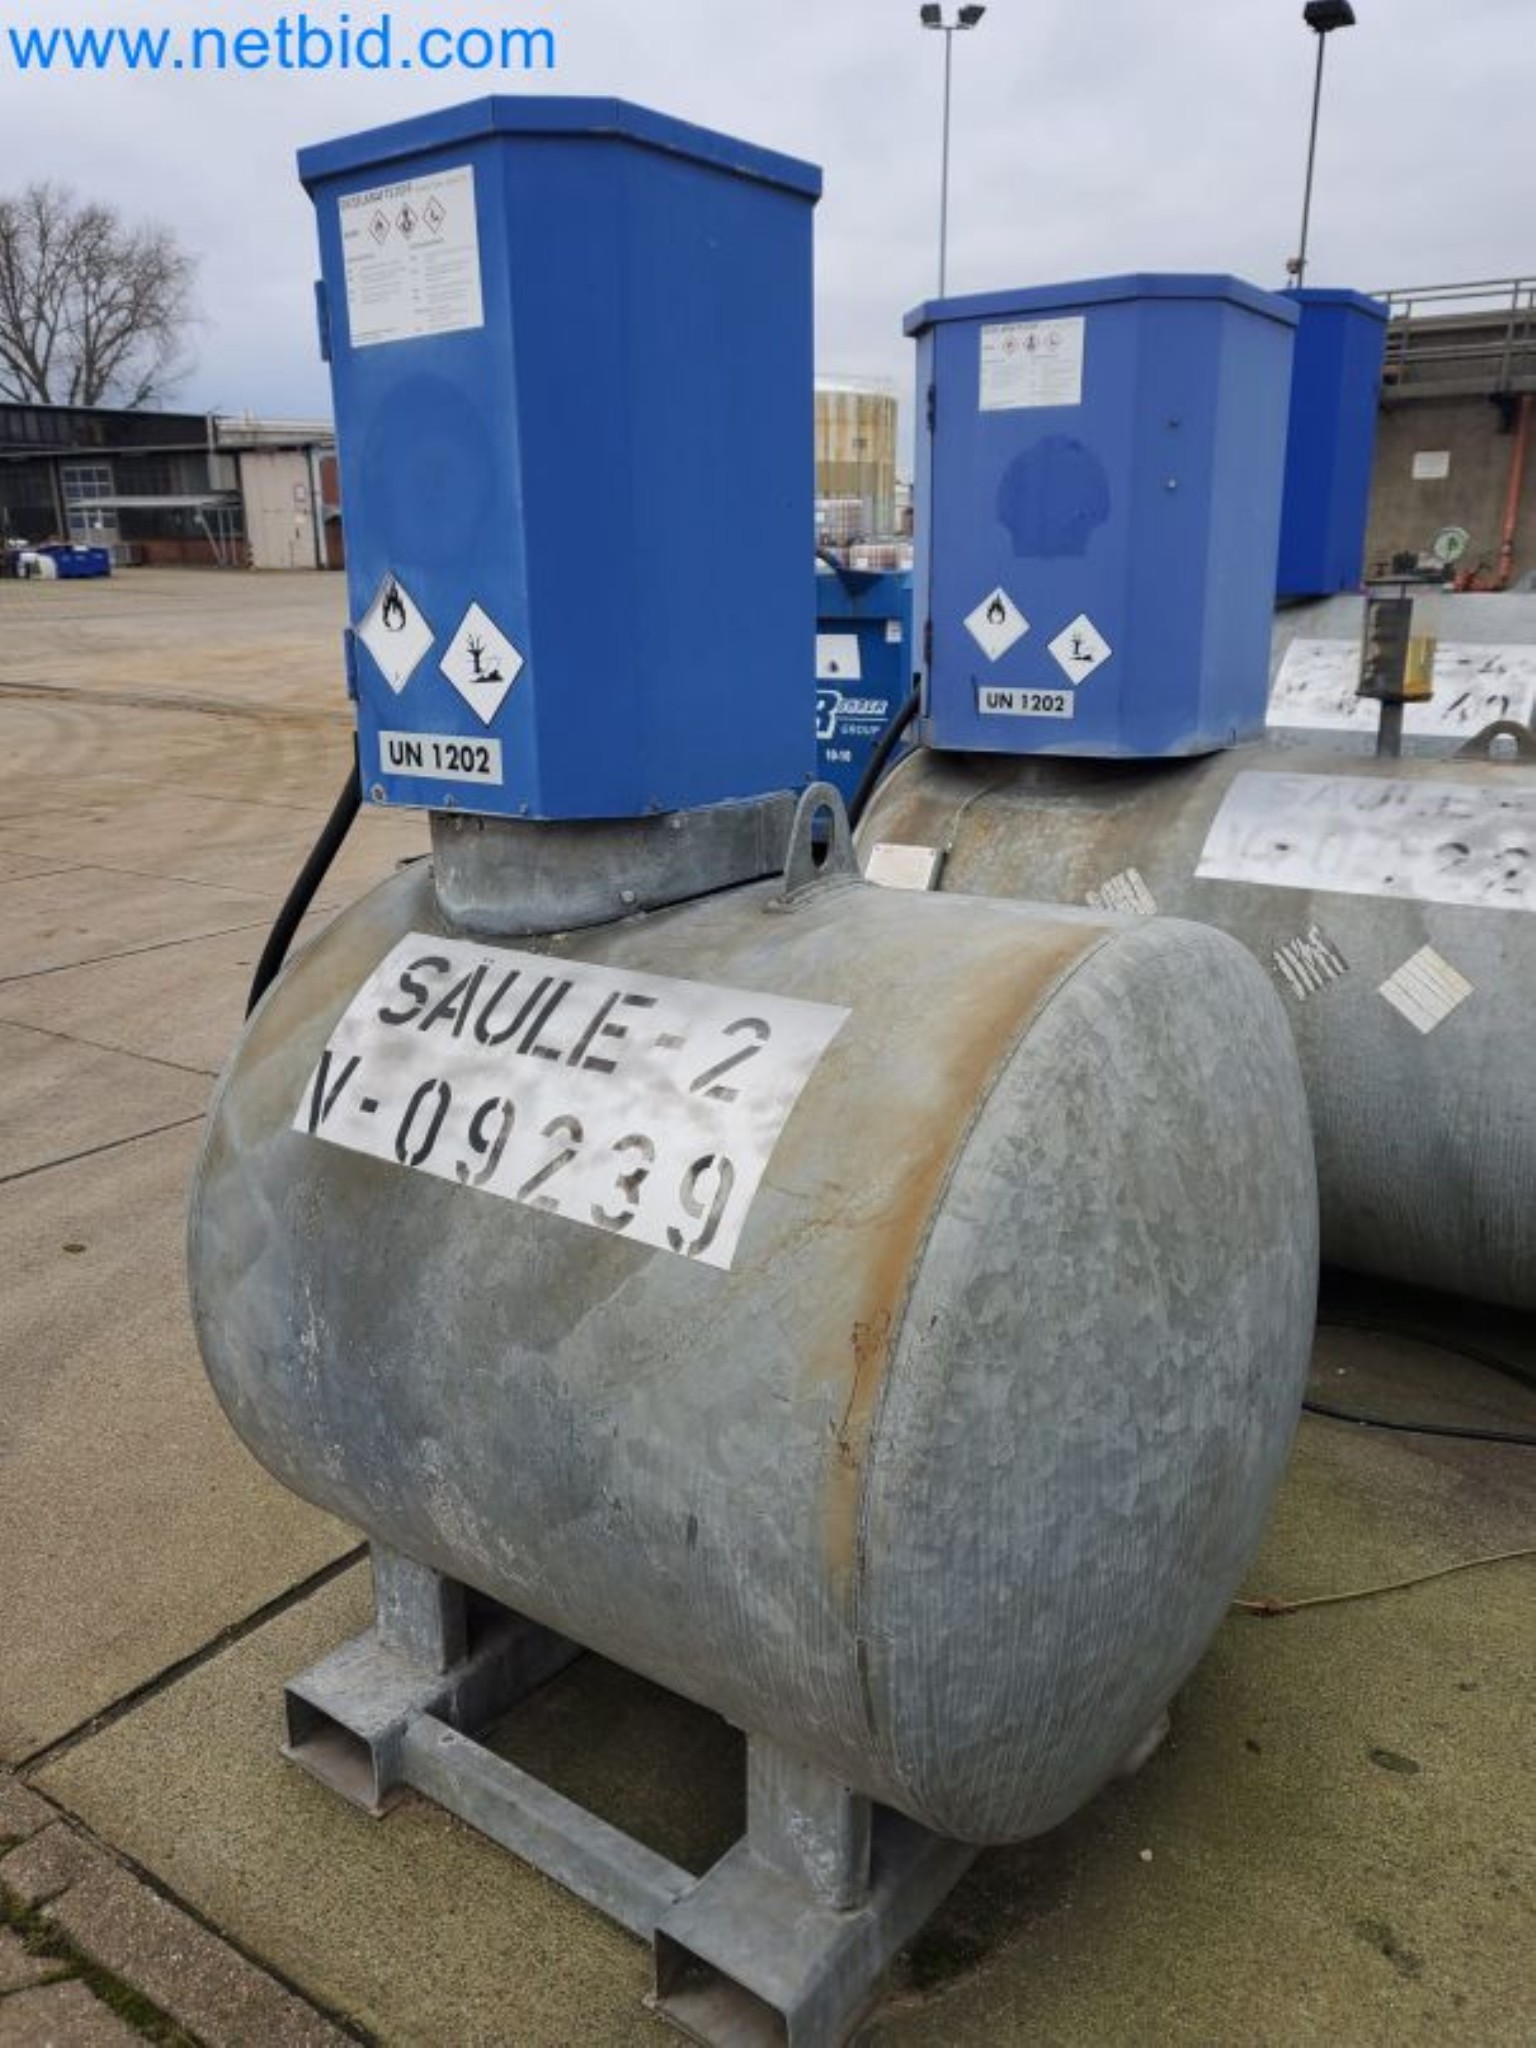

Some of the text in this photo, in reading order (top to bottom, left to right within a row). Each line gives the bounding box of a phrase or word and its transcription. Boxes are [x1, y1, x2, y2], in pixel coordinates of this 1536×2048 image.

[986, 692, 1065, 712] UN 1202
[388, 740, 491, 774] UN 1202
[308, 1050, 735, 1258] V-09239
